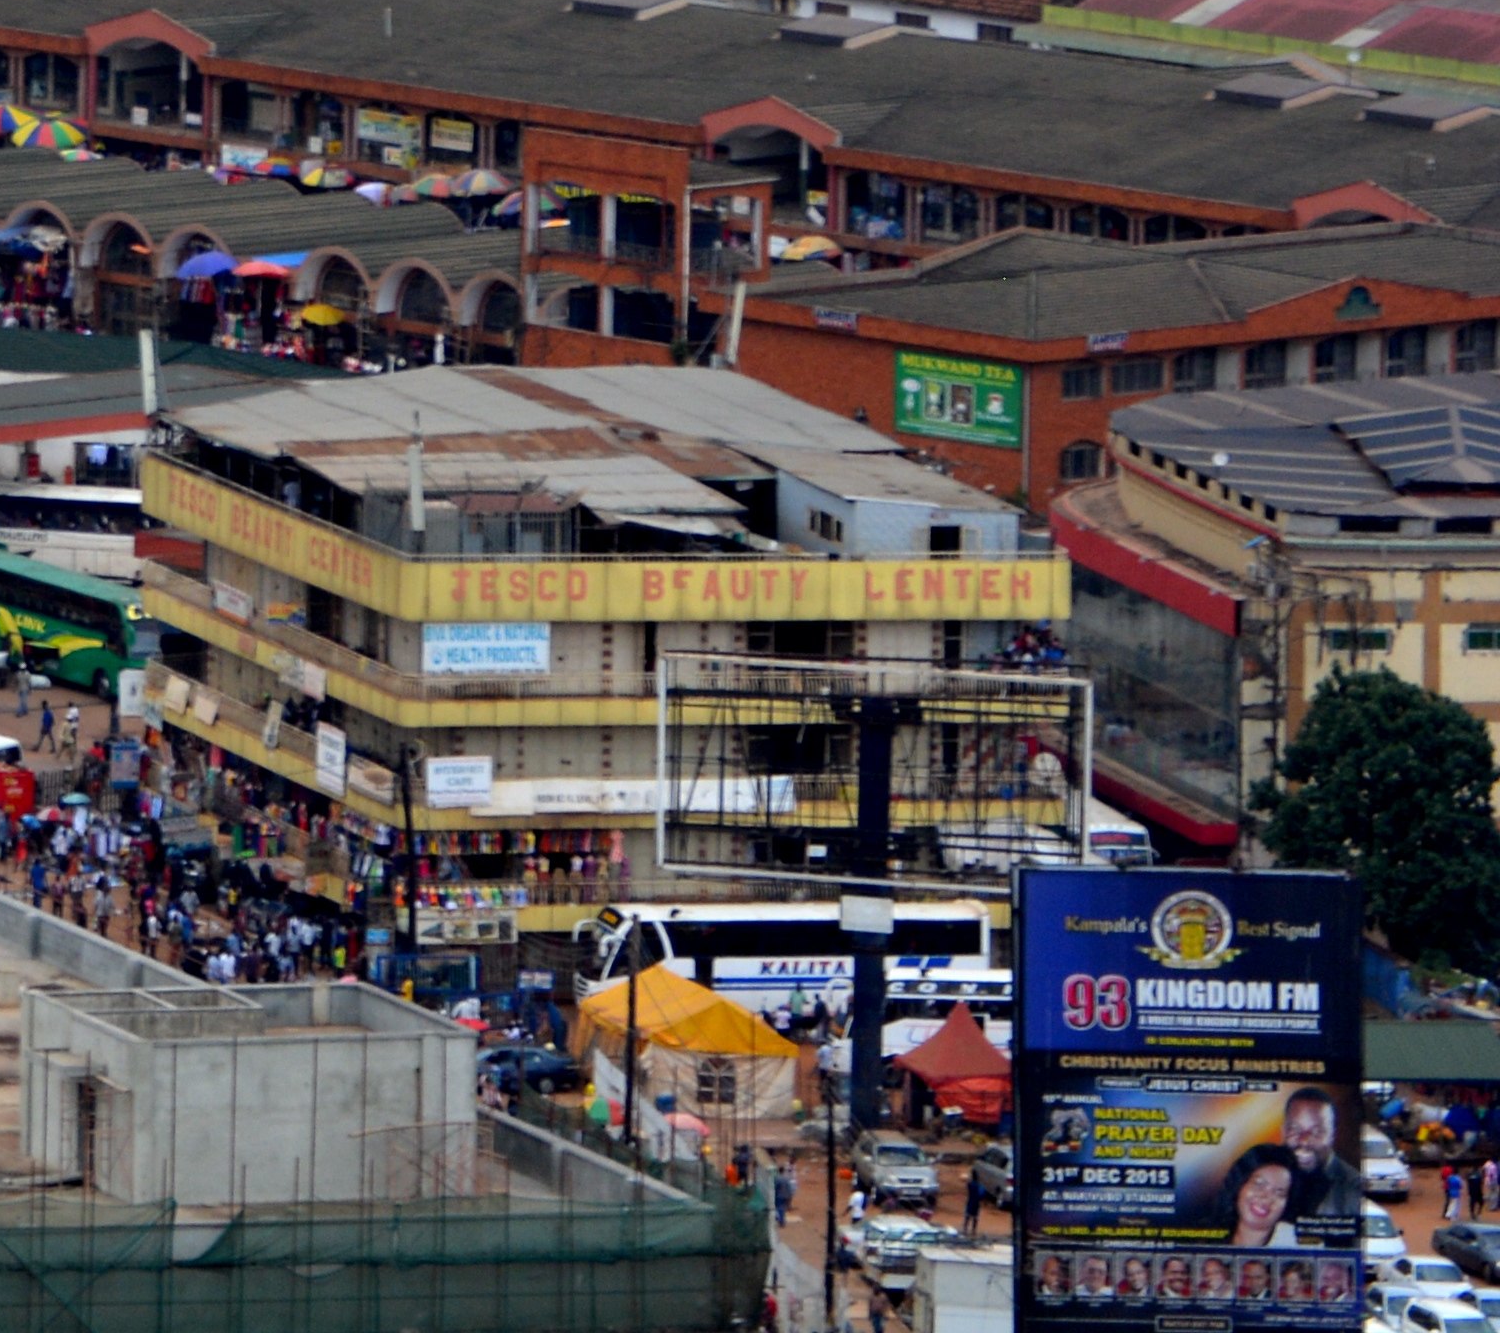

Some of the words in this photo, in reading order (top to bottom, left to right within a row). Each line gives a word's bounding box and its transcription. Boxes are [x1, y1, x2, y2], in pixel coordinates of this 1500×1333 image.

[985, 365, 1017, 382] TEA
[447, 646, 481, 665] HEALTH
[1065, 915, 1148, 936] Kampala's
[1273, 921, 1321, 940] Signal
[759, 961, 848, 977] KALITA
[1063, 974, 1131, 1031] 93
[1136, 979, 1273, 1011] KINGDOM
[1278, 982, 1320, 1012] FM
[1059, 1055, 1171, 1071] CHRISTIANITY
[1175, 1058, 1229, 1072] FOCUS
[1233, 1059, 1325, 1074] MINISTRIES
[1147, 1079, 1189, 1091] JESUS
[1192, 1080, 1240, 1092] CHRIST
[1094, 1109, 1168, 1122] NATIONAL
[1094, 1126, 1178, 1142] PRAYER
[1181, 1128, 1224, 1144] DAY
[1094, 1147, 1124, 1158] AND
[1129, 1147, 1177, 1160] NIGHT
[1083, 1168, 1121, 1183] DEC
[1126, 1169, 1170, 1184] 2015
